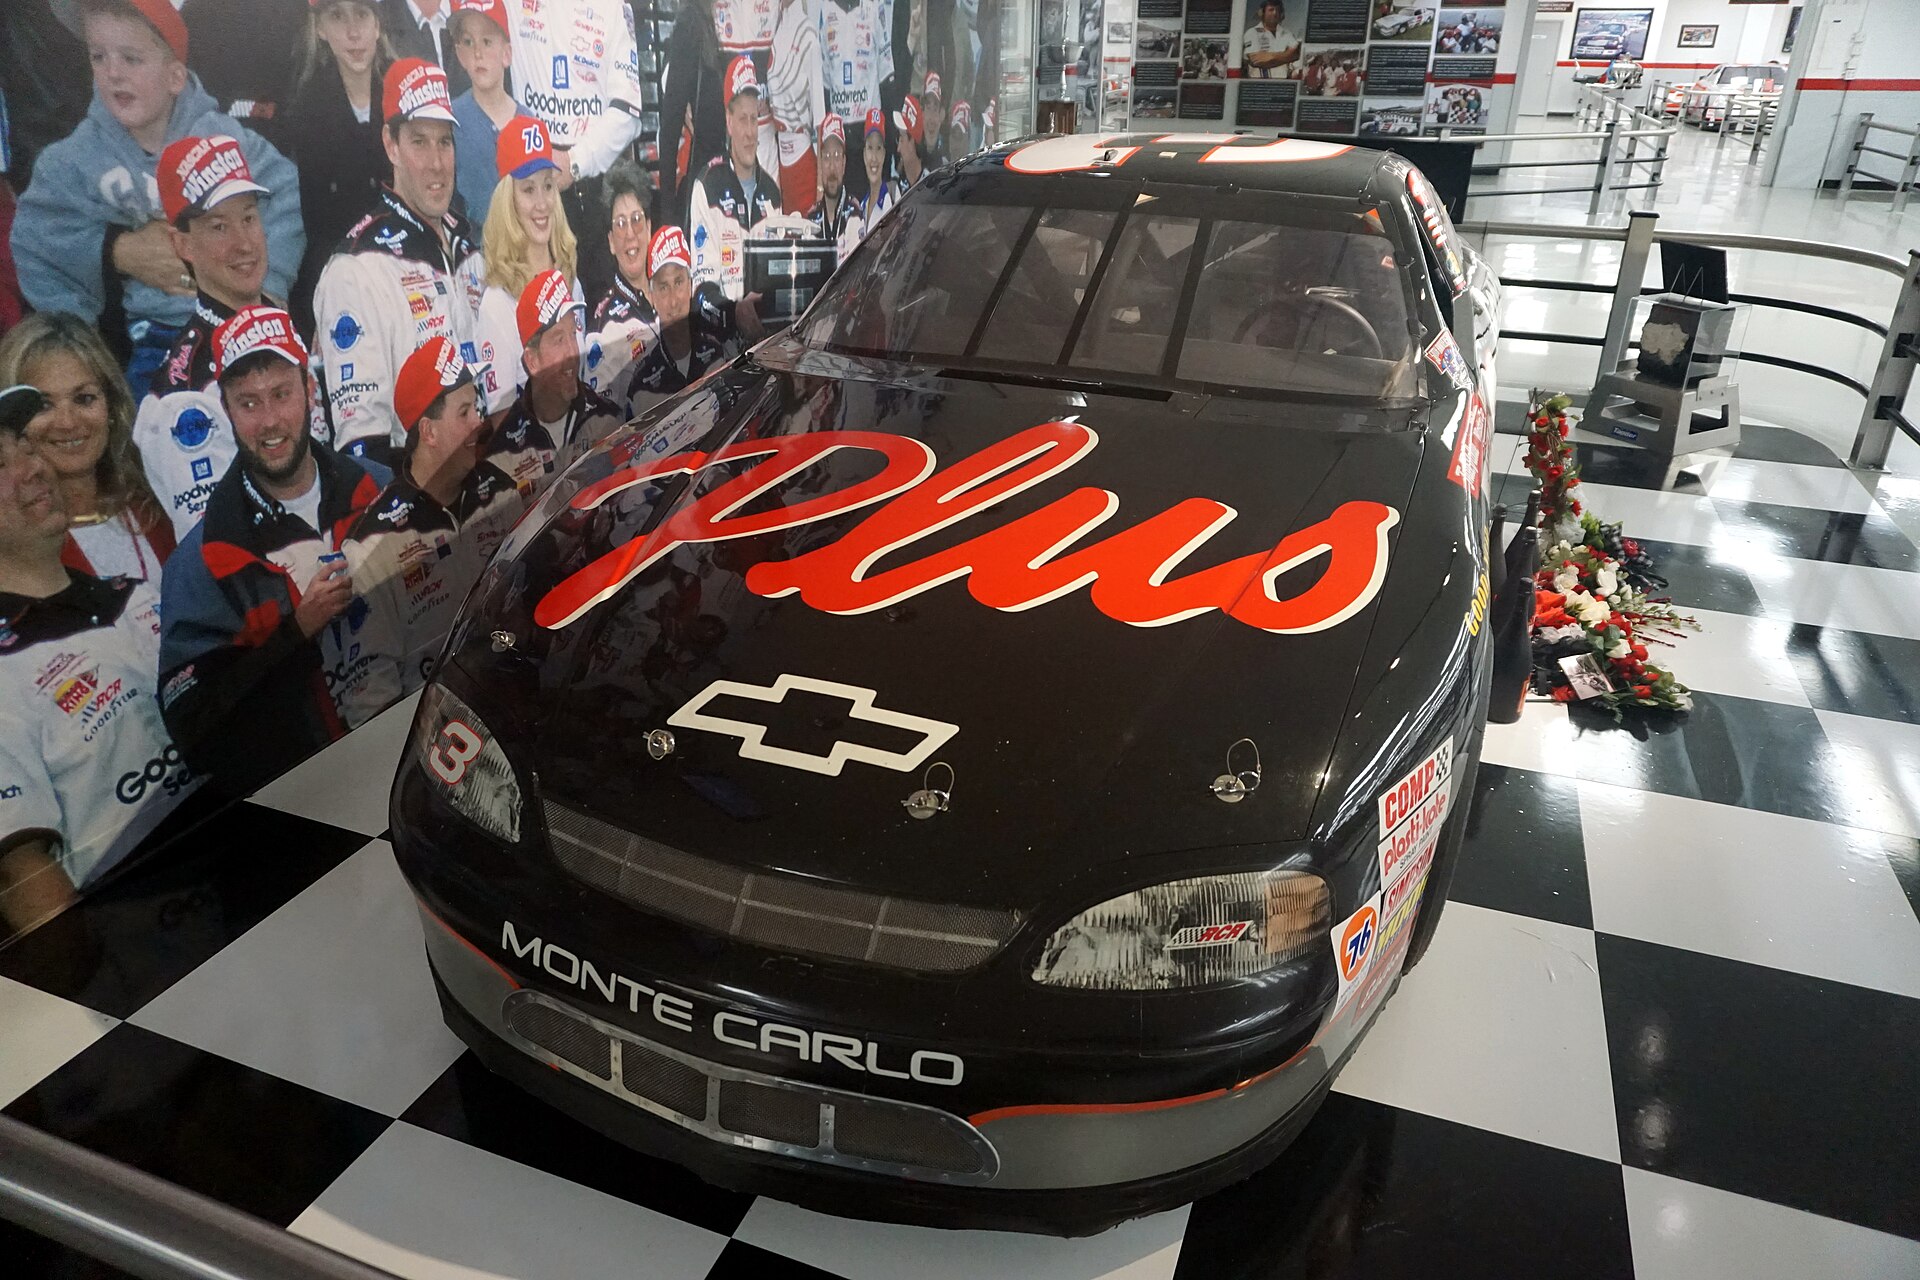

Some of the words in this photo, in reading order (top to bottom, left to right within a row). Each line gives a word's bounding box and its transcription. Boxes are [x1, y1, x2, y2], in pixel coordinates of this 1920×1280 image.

[524, 82, 602, 116] Goodwrench
[522, 125, 543, 151] 76
[181, 147, 246, 204] Winston
[534, 423, 1400, 636] Plus
[429, 719, 483, 785] 3
[1385, 758, 1435, 830] COMP
[1384, 792, 1447, 877] plasti-kote
[1195, 922, 1248, 943] RCR
[1347, 917, 1372, 973] 76
[502, 920, 693, 1032] MONTE
[712, 1011, 965, 1086] CARLO
